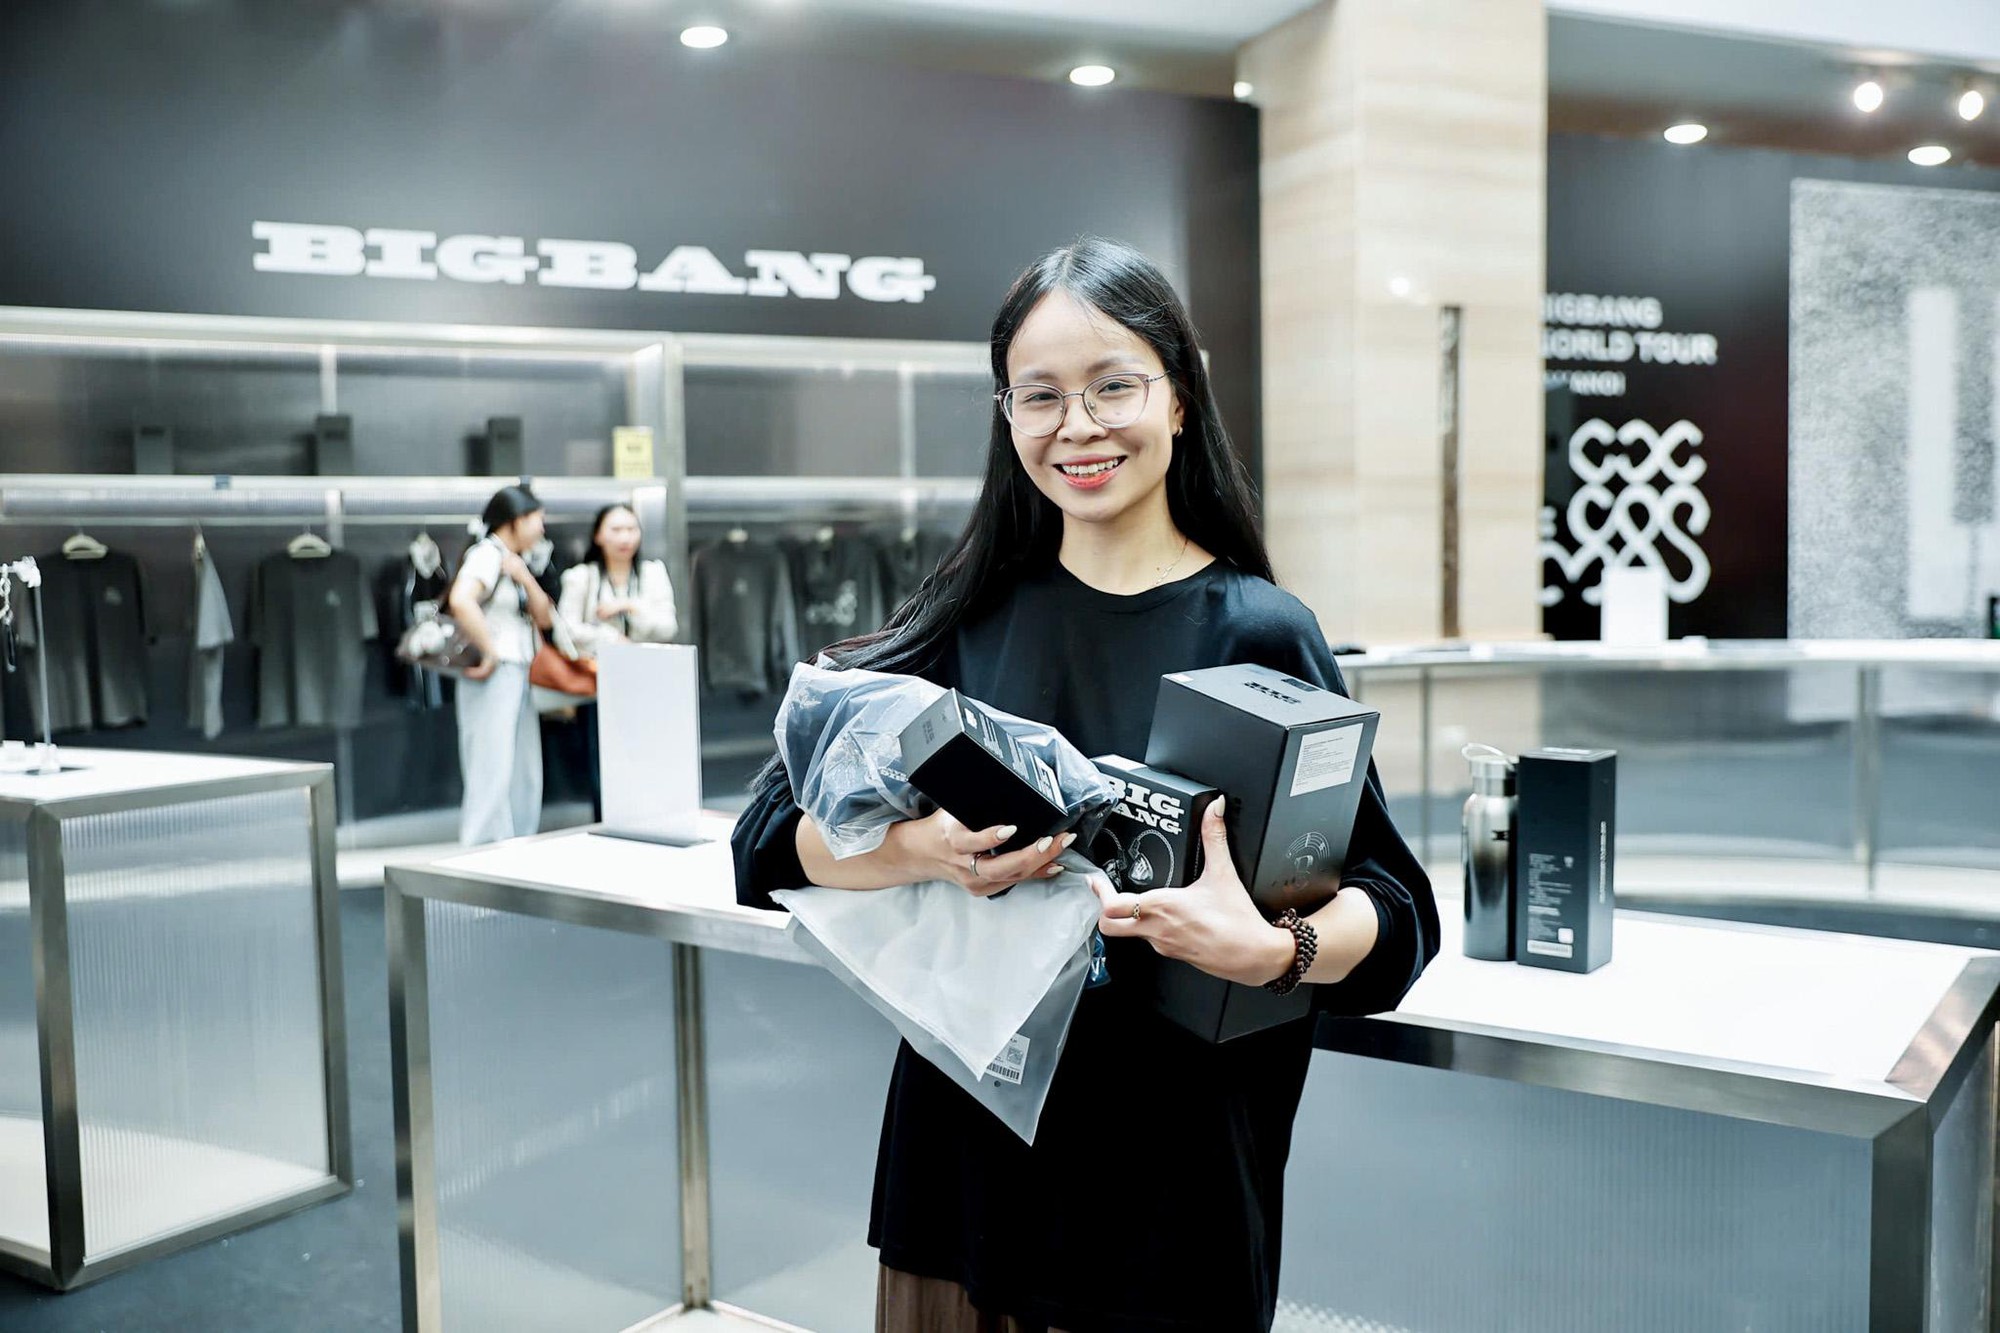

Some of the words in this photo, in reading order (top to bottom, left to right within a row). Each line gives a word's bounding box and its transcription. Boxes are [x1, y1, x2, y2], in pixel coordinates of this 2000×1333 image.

[252, 220, 937, 303] BIGBANG
[1543, 293, 1663, 329] IGBANG
[1633, 331, 1718, 366] TOUR
[1111, 802, 1183, 836] ANG
